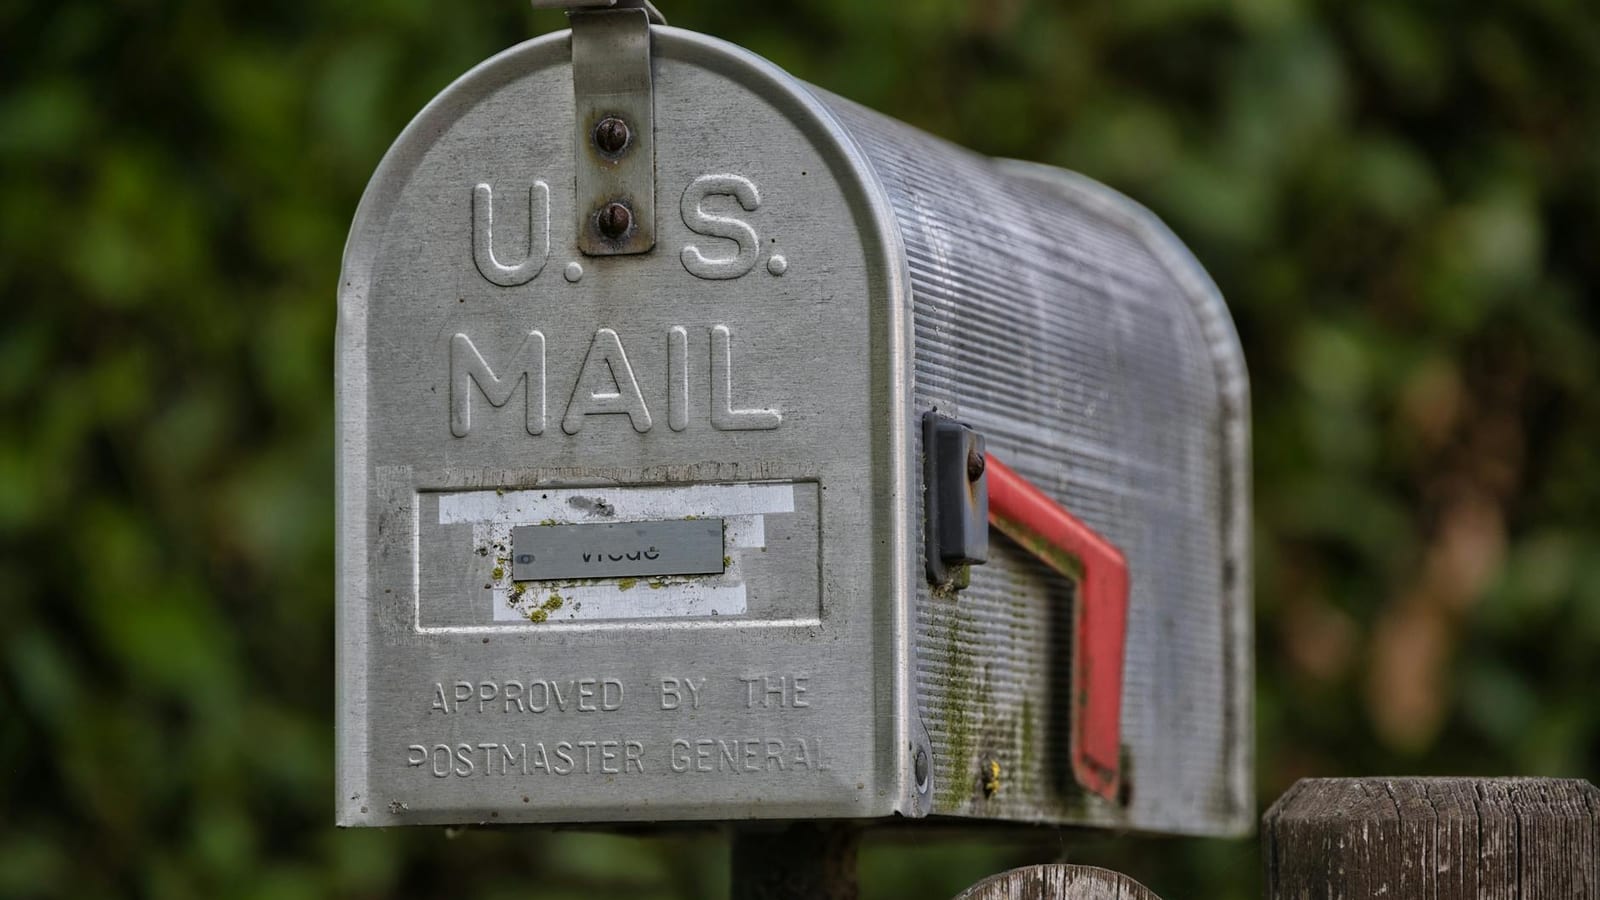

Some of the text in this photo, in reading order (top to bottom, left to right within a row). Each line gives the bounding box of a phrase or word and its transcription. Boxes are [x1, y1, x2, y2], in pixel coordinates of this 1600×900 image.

[450, 325, 783, 438] MAIL
[430, 674, 812, 716] APPROVED BY THE
[408, 738, 832, 778] POSTMASTER GENERAL
